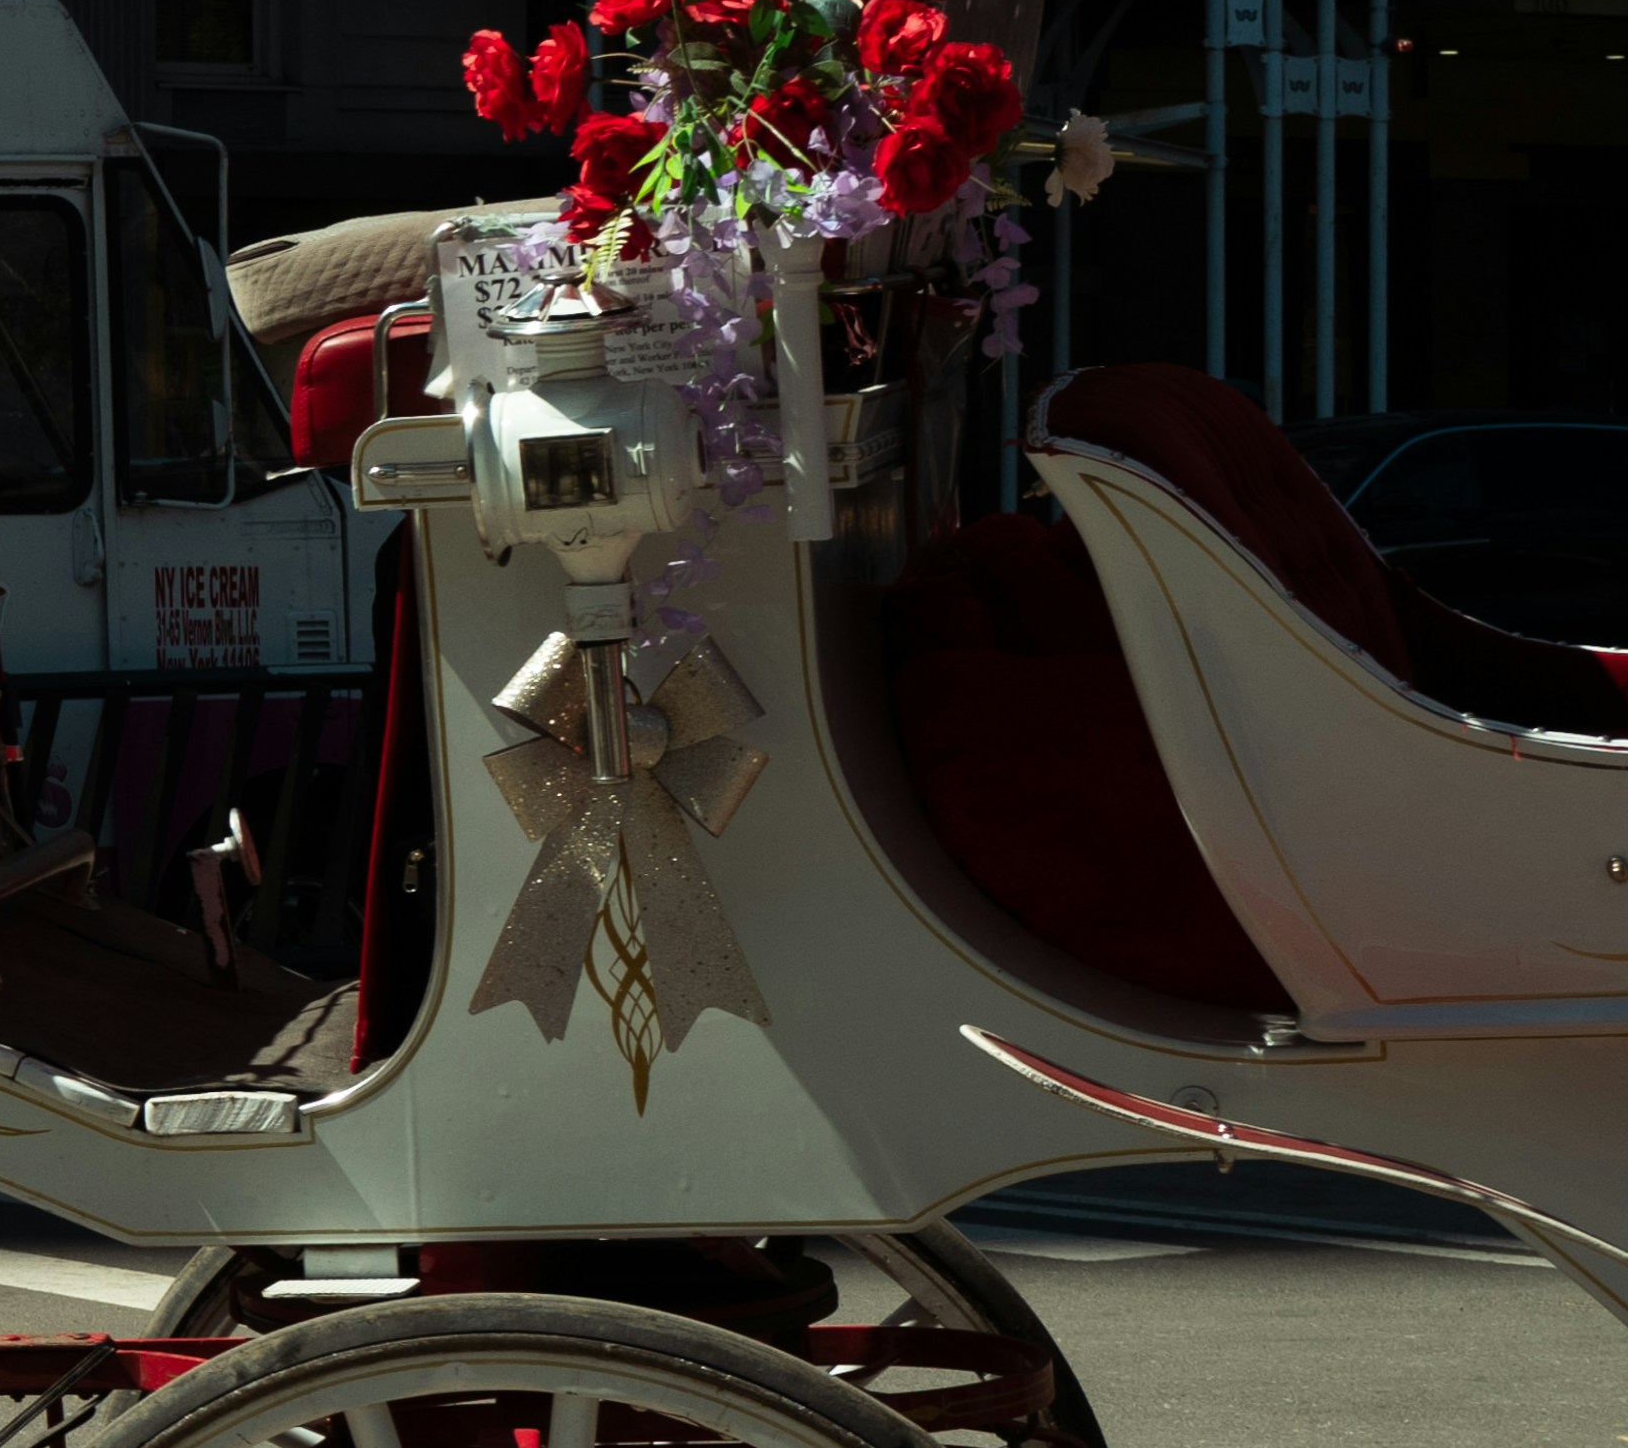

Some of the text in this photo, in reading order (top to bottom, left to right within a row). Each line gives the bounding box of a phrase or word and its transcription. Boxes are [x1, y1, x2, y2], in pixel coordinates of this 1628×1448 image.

[155, 566, 260, 609] NY ICE CREAM
[156, 609, 180, 646] 31-65
[183, 609, 213, 646] Vernon
[215, 609, 237, 646] Blvd.
[156, 647, 186, 670] New
[189, 647, 218, 670] York
